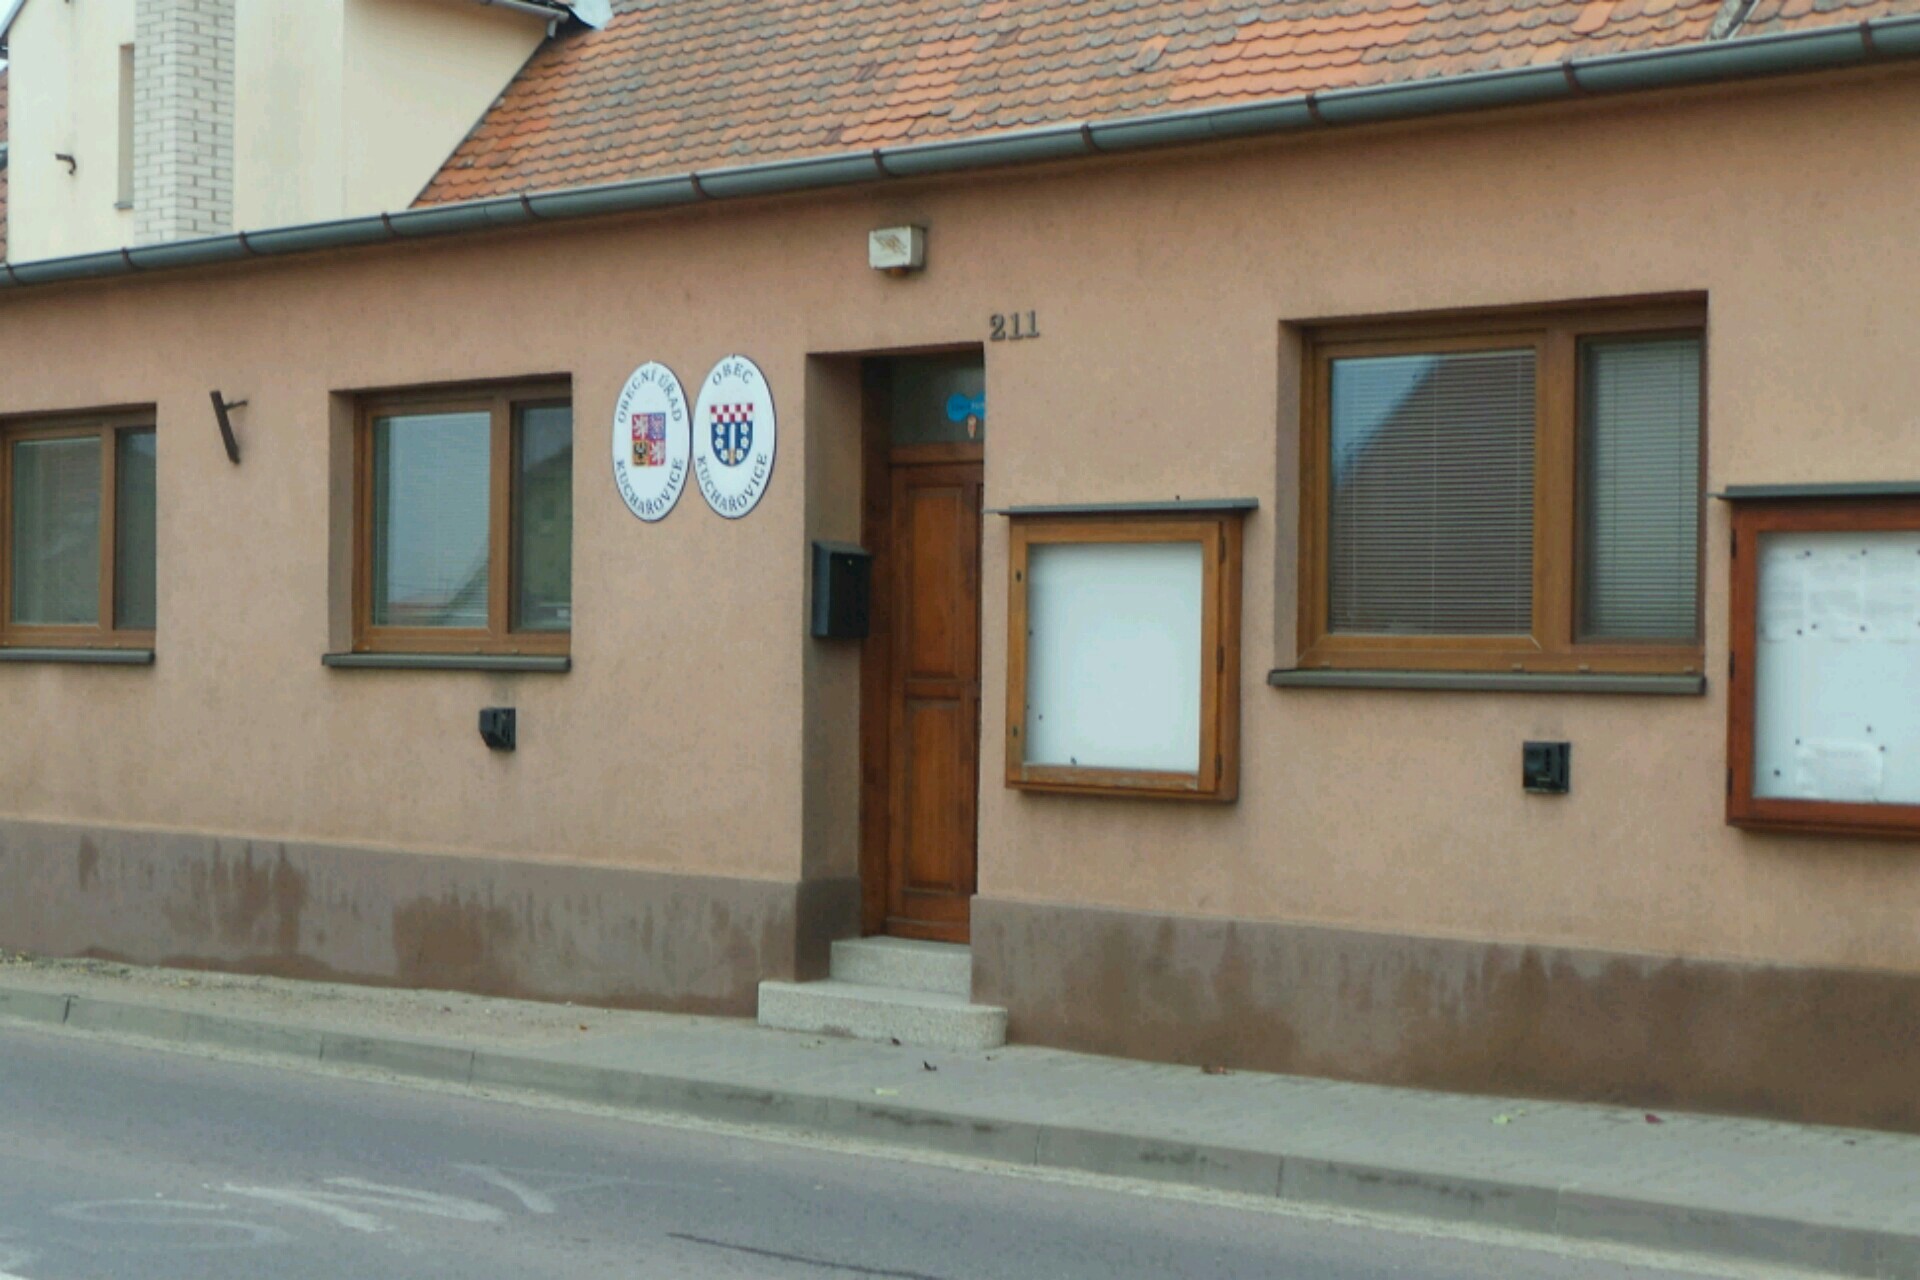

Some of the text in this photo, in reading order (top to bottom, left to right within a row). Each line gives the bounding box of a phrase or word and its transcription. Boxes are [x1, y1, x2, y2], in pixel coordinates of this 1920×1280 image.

[991, 310, 1040, 341] 211
[712, 362, 754, 386] OBEC
[617, 367, 656, 423] OBECNÍ
